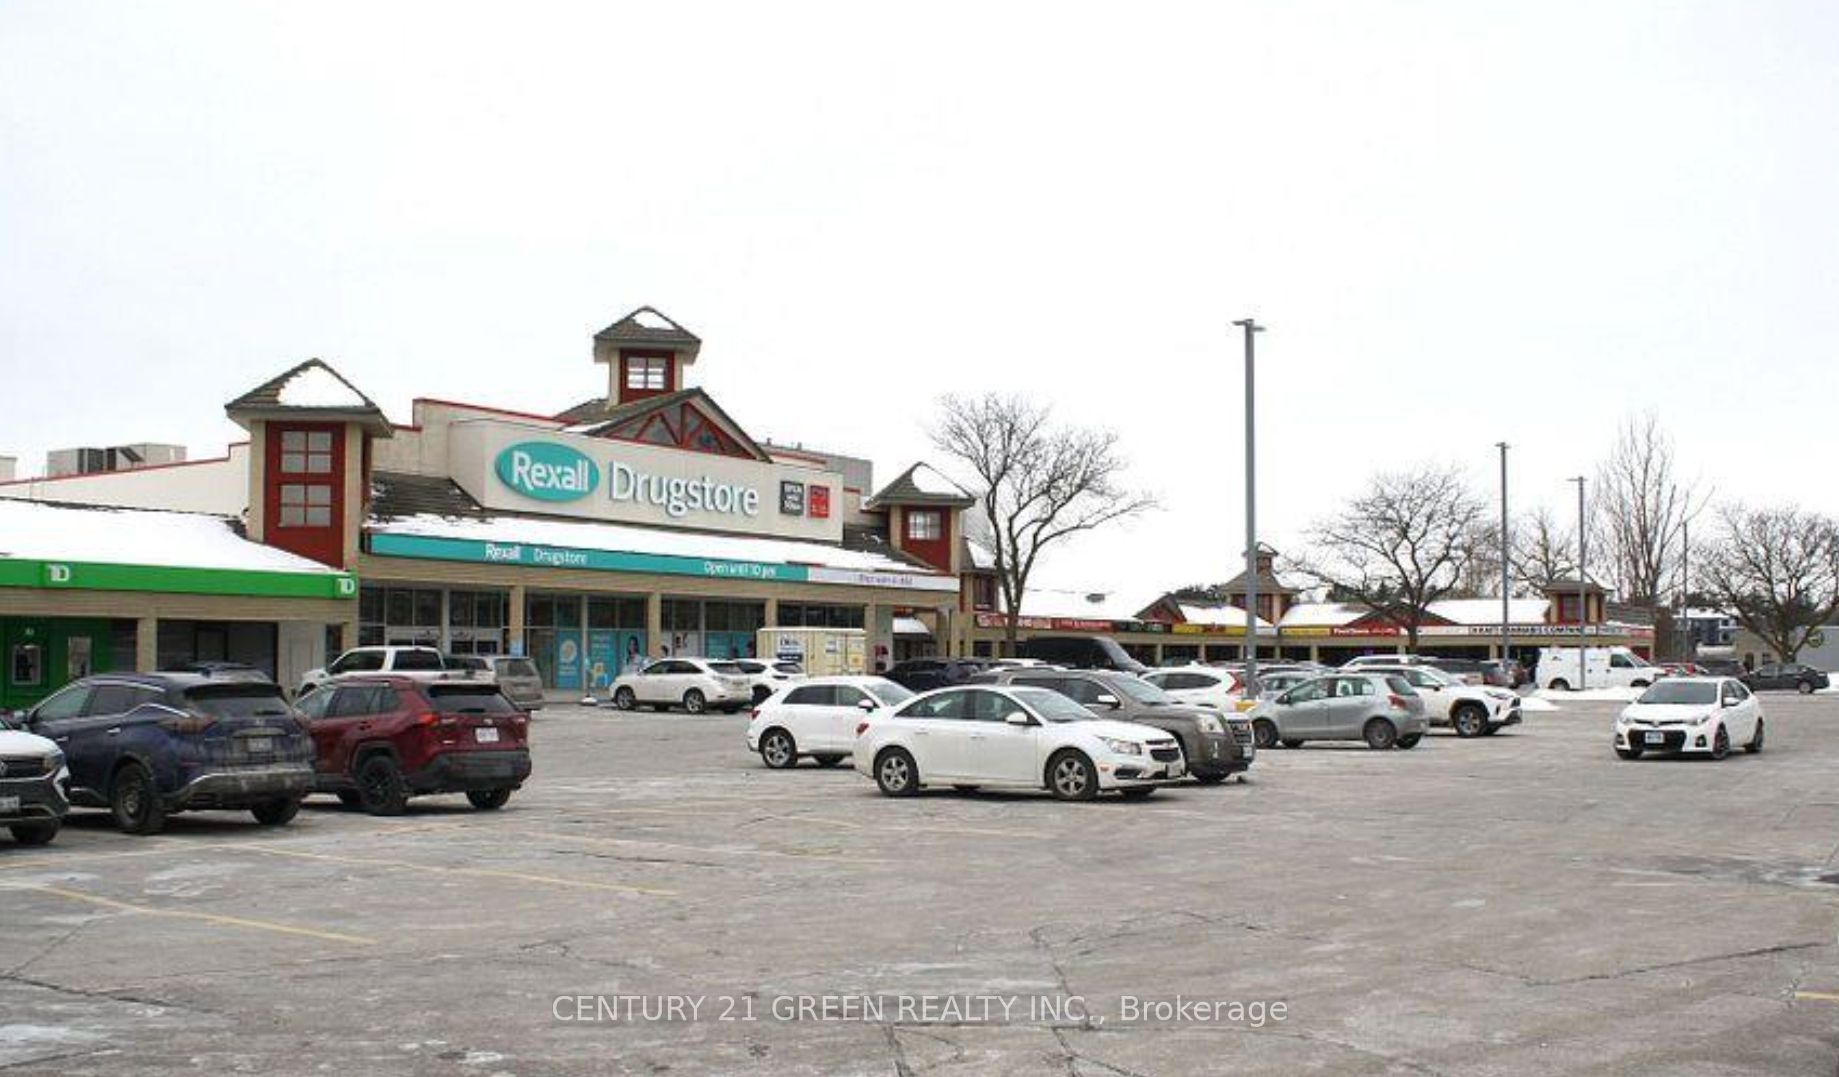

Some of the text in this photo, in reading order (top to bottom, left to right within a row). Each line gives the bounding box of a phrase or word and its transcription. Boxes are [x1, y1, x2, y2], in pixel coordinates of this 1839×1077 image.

[511, 450, 589, 491] Rexall
[609, 460, 759, 517] Drugstore
[485, 543, 588, 566] Rexall Drugstore
[48, 564, 70, 581] TD
[704, 560, 728, 575] Open
[750, 563, 761, 576] 10
[337, 577, 355, 594] TD
